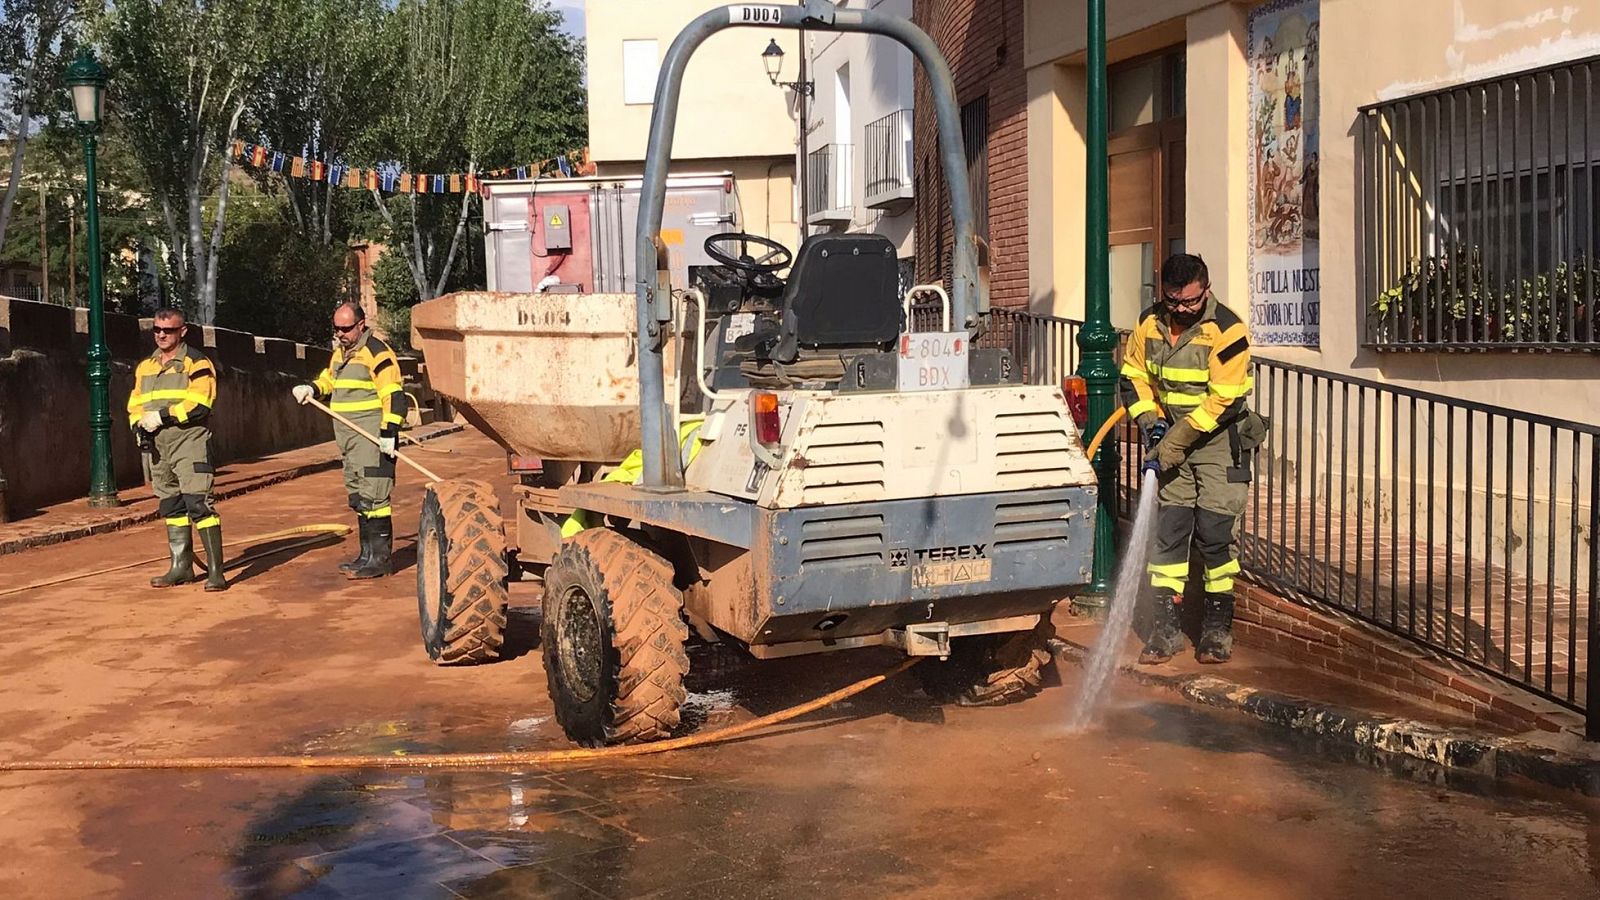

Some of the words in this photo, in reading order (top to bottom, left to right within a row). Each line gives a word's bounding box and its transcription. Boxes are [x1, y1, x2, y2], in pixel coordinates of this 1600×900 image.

[1256, 270, 1289, 293] CAPILLA
[1293, 268, 1320, 292] NUEST
[1256, 300, 1282, 326] SEÑORA
[1284, 303, 1293, 326] DE
[1296, 302, 1306, 326] LA
[919, 366, 950, 386] BDX
[914, 543, 987, 561] TEREX
